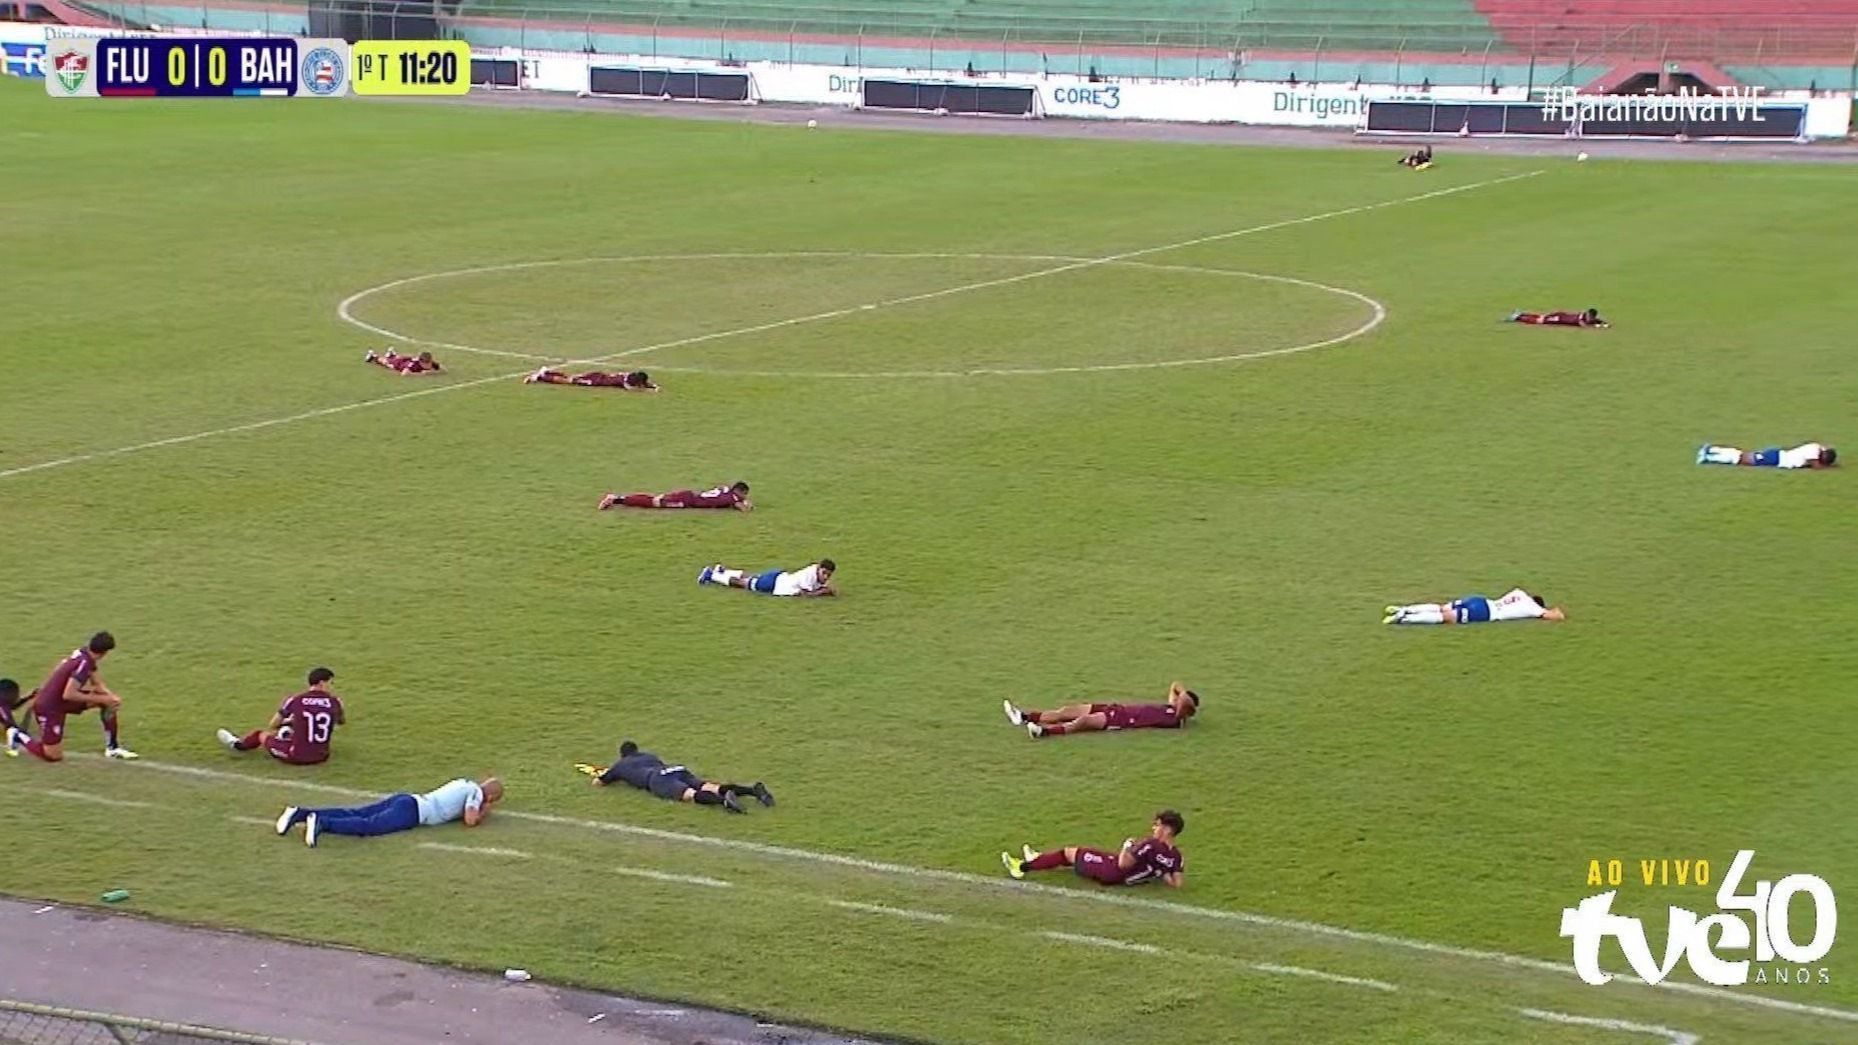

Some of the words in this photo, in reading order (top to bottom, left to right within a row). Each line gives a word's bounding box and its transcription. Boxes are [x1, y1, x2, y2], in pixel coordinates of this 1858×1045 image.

[1054, 87, 1120, 109] CORE3
[1273, 92, 1369, 119] Dirigent
[302, 711, 331, 743] 13
